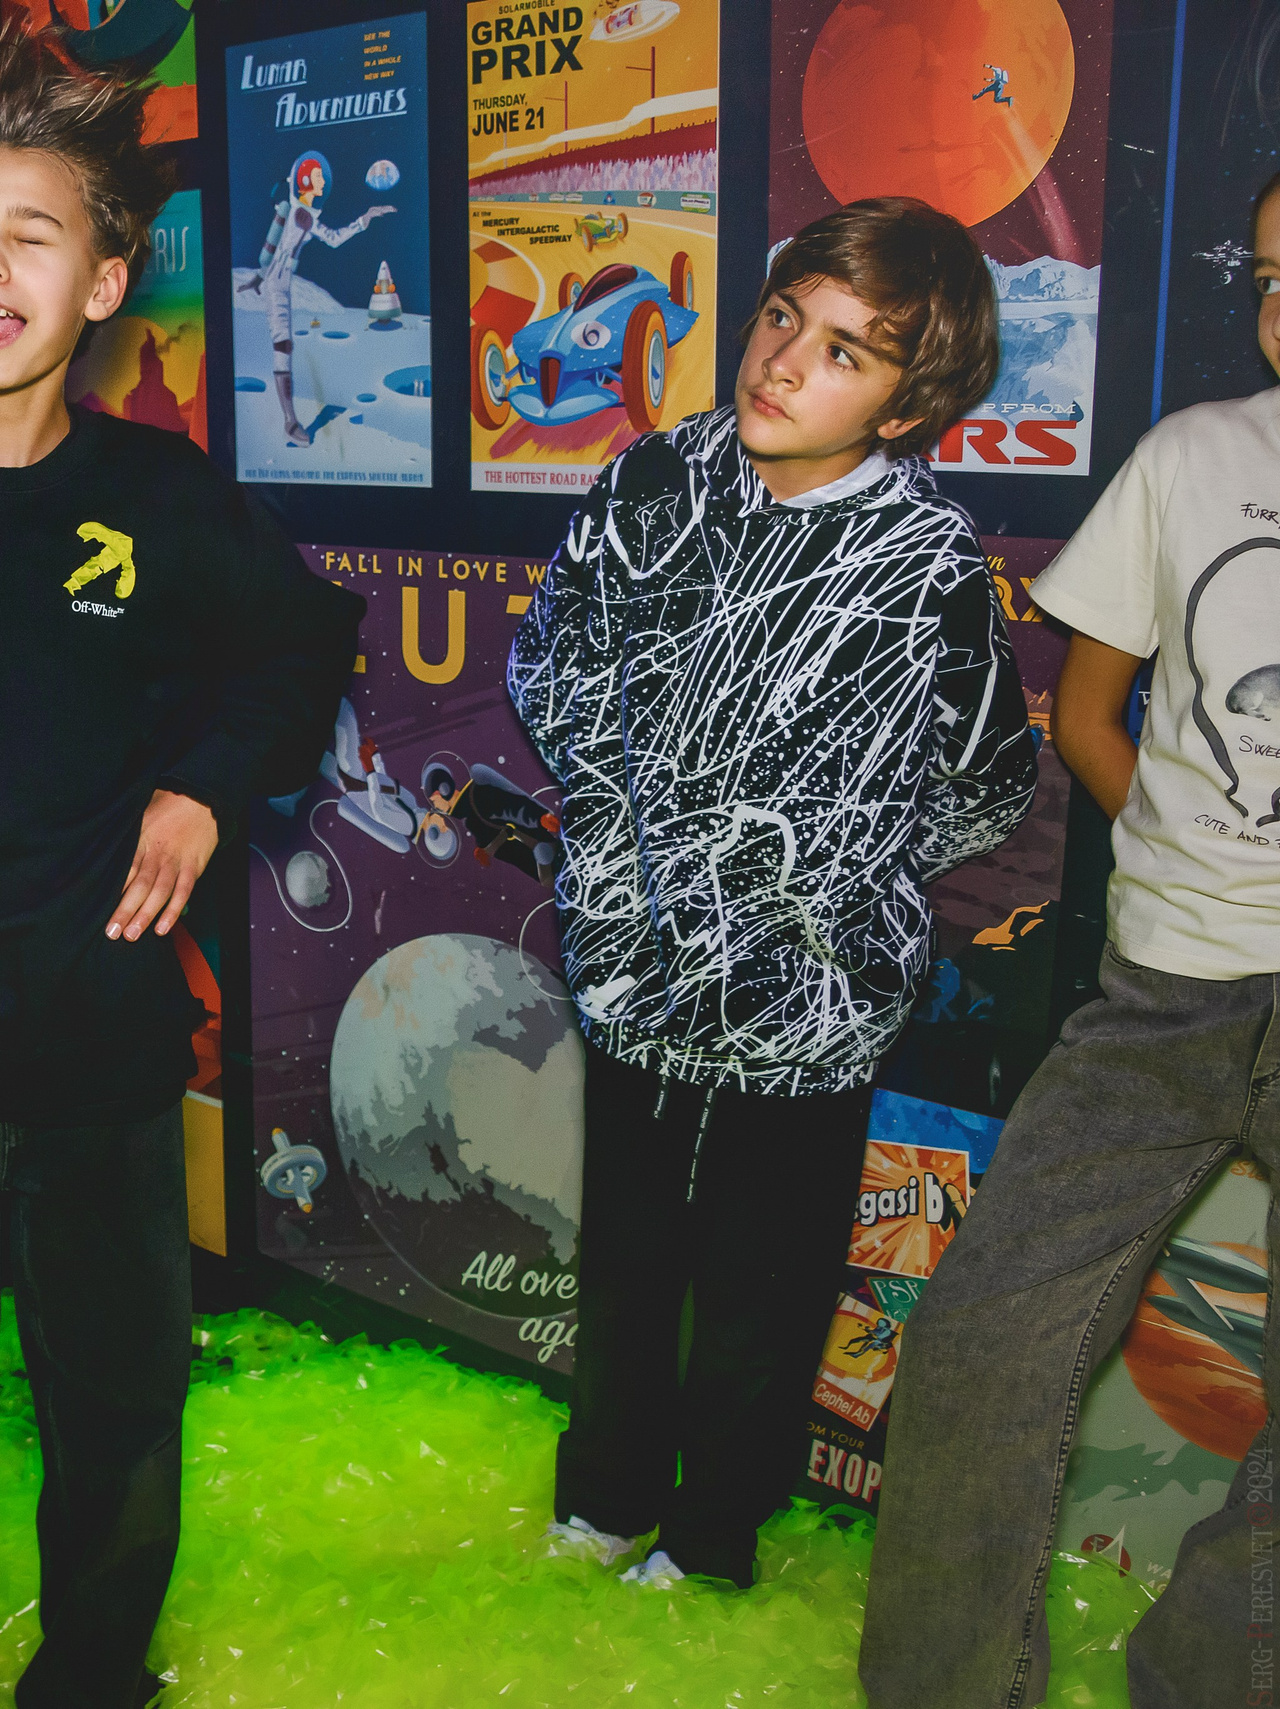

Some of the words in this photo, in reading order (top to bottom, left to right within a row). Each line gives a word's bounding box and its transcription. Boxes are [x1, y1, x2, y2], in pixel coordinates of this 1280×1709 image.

[499, 0, 555, 14] SOLARMOBILE
[471, 6, 583, 46] GRAND
[363, 44, 388, 54] WORLD
[472, 34, 583, 85] PRIX
[241, 55, 307, 90] LUNAR
[275, 87, 407, 128] ADVENTURES
[473, 93, 528, 110] THURSDAY,
[472, 110, 519, 136] JUNE
[525, 106, 544, 130] 21
[482, 217, 520, 227] MERCURY
[497, 224, 560, 236] INTERGALACTIC
[155, 226, 189, 273] RIS
[529, 234, 573, 245] SPEEDWAY
[582, 323, 600, 347] 6
[1001, 403, 1077, 414] FROM
[923, 419, 1077, 467] RS
[485, 471, 502, 483] THE
[505, 471, 547, 485] HOTTEST
[550, 472, 577, 486] ROAD
[1240, 503, 1280, 530] FURR
[325, 551, 382, 574] FALL
[397, 556, 422, 577] IN
[438, 559, 507, 583] LOVE
[1194, 814, 1231, 835] CUTE
[1237, 830, 1269, 846] AND
[854, 1176, 920, 1226] gasi
[924, 1172, 945, 1224] b
[461, 1250, 517, 1292] All
[814, 1383, 856, 1415] Cephei
[851, 1406, 871, 1426] Ab
[830, 1430, 865, 1450] YOUR
[807, 1438, 883, 1503] EXOP
